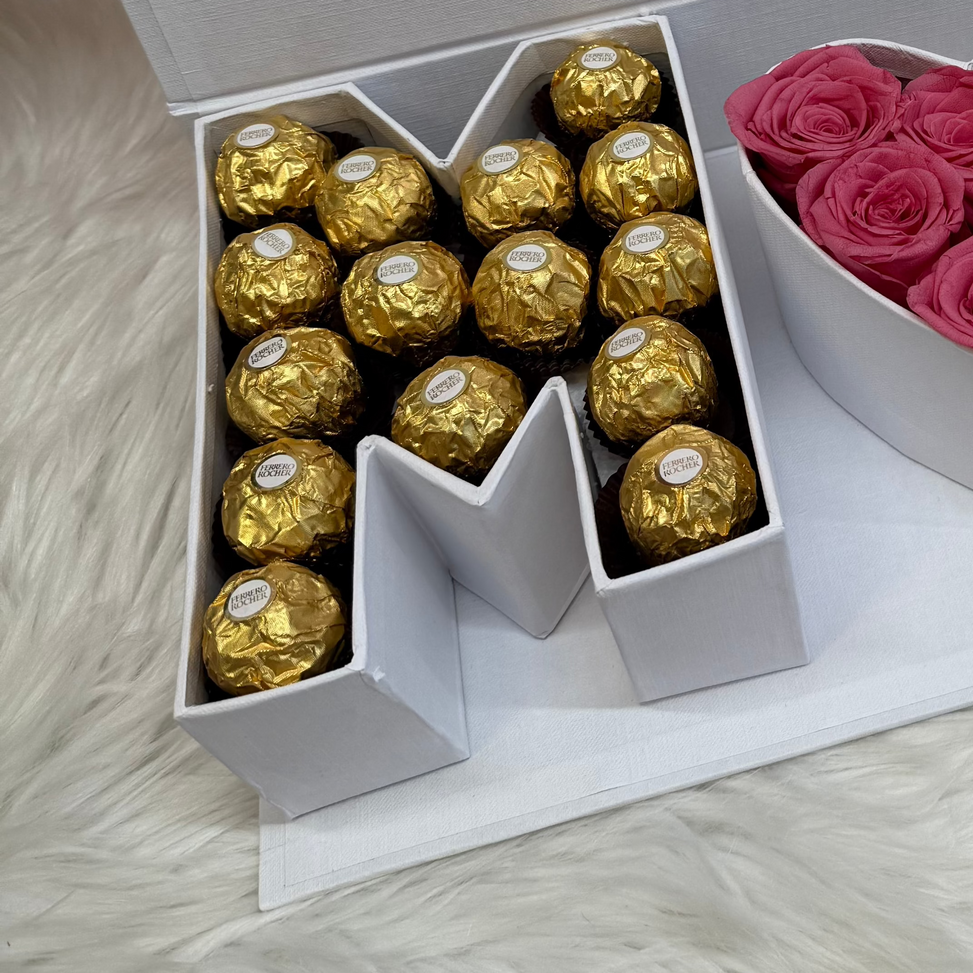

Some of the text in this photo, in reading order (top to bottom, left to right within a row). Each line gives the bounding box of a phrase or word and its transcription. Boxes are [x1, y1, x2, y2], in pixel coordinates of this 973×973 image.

[239, 132, 271, 142] ROCHER
[240, 127, 273, 136] FERRERO
[614, 135, 647, 150] FERRERO
[616, 140, 649, 155] ROCHER
[484, 150, 517, 160] FERRERO
[484, 156, 516, 167] ROCHER
[340, 166, 373, 174] ROCHER
[341, 160, 375, 169] FERRERO
[261, 232, 290, 250] FERRERO
[627, 229, 662, 241] FERRERO
[629, 235, 662, 247] ROCHER
[258, 234, 284, 254] ROCHER
[511, 250, 546, 258] FERRERO
[380, 261, 416, 272] FERRERO
[380, 267, 415, 278] ROCHER
[610, 331, 644, 347] FERRERO
[610, 336, 642, 353] ROCHER
[250, 338, 283, 360] FERRERO
[251, 344, 284, 365] ROCHER
[427, 371, 460, 396] FERRERO
[430, 377, 463, 401] ROCHER
[260, 462, 295, 470] FERRERO
[662, 454, 699, 470] FERRERO
[663, 460, 700, 477] ROCHER
[257, 468, 292, 478] ROCHER
[230, 584, 268, 604] FERRERO
[231, 591, 268, 611] ROCHER
